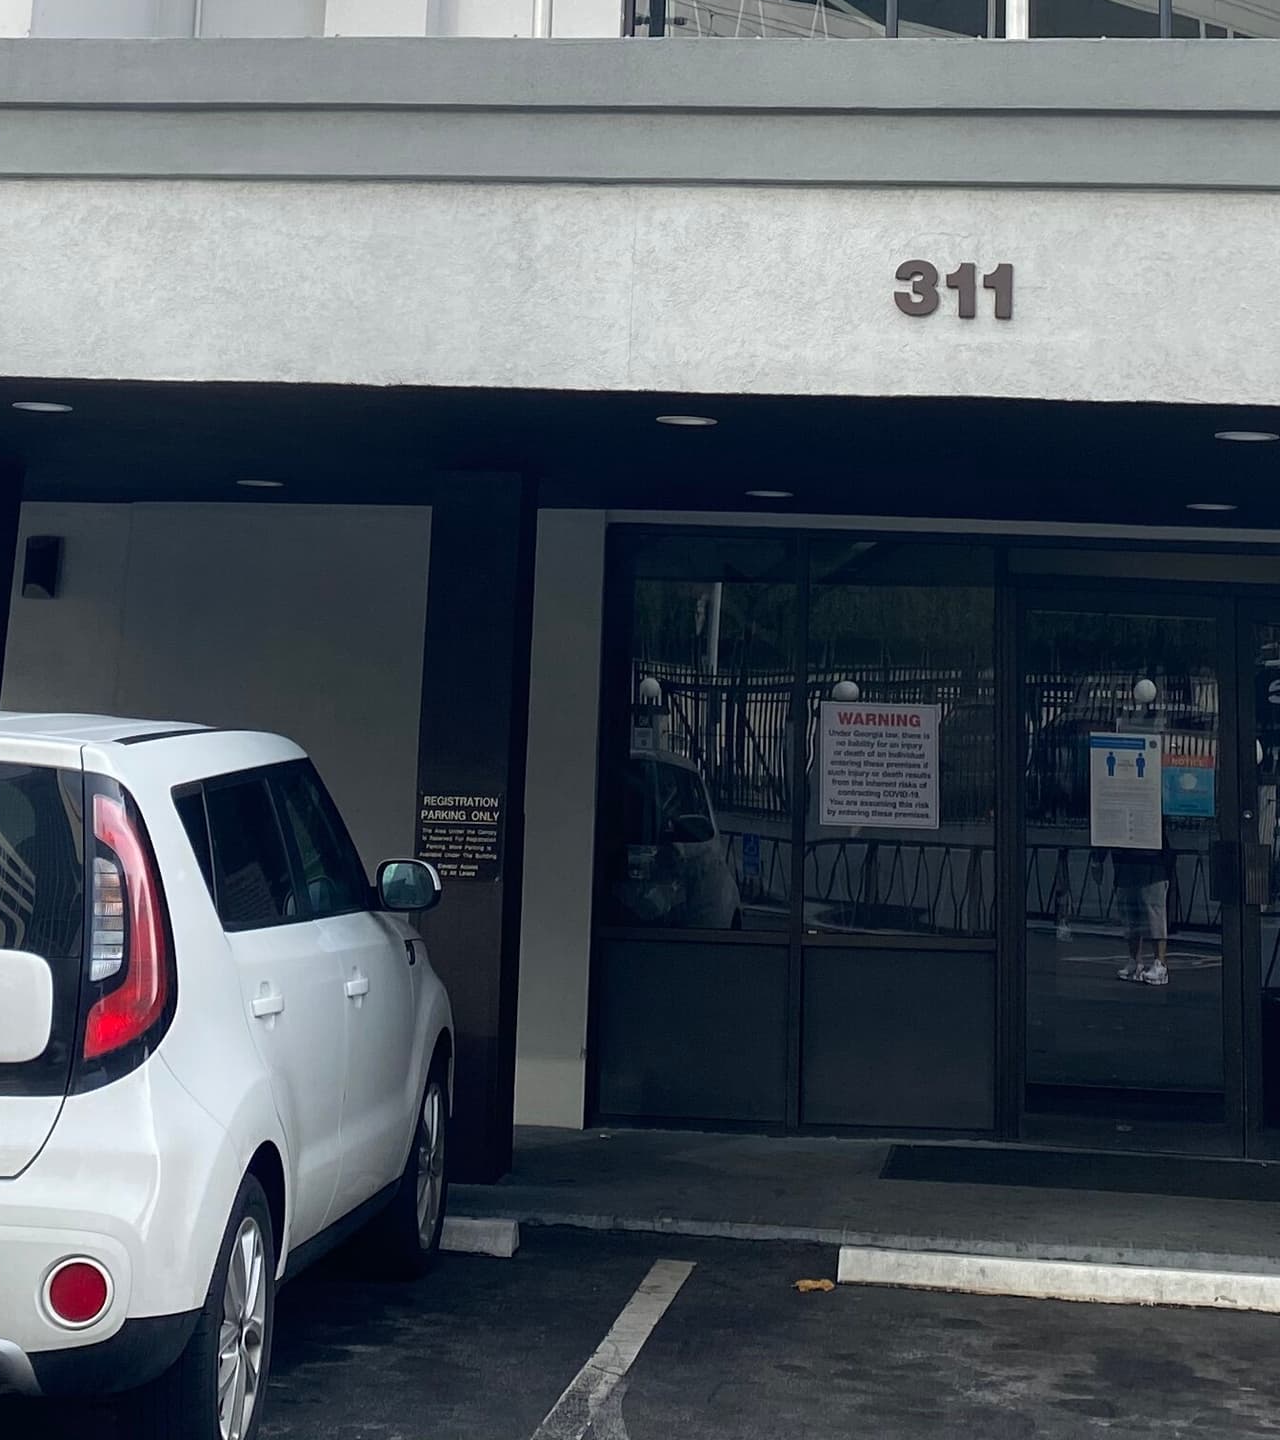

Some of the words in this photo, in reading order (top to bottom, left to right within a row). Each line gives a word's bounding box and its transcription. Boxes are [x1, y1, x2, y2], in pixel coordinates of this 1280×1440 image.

[894, 260, 1013, 319] 311
[837, 711, 921, 727] WARNING
[424, 796, 499, 807] REGISTRATION
[421, 810, 466, 821] PARKING
[471, 811, 500, 821] ONLY
